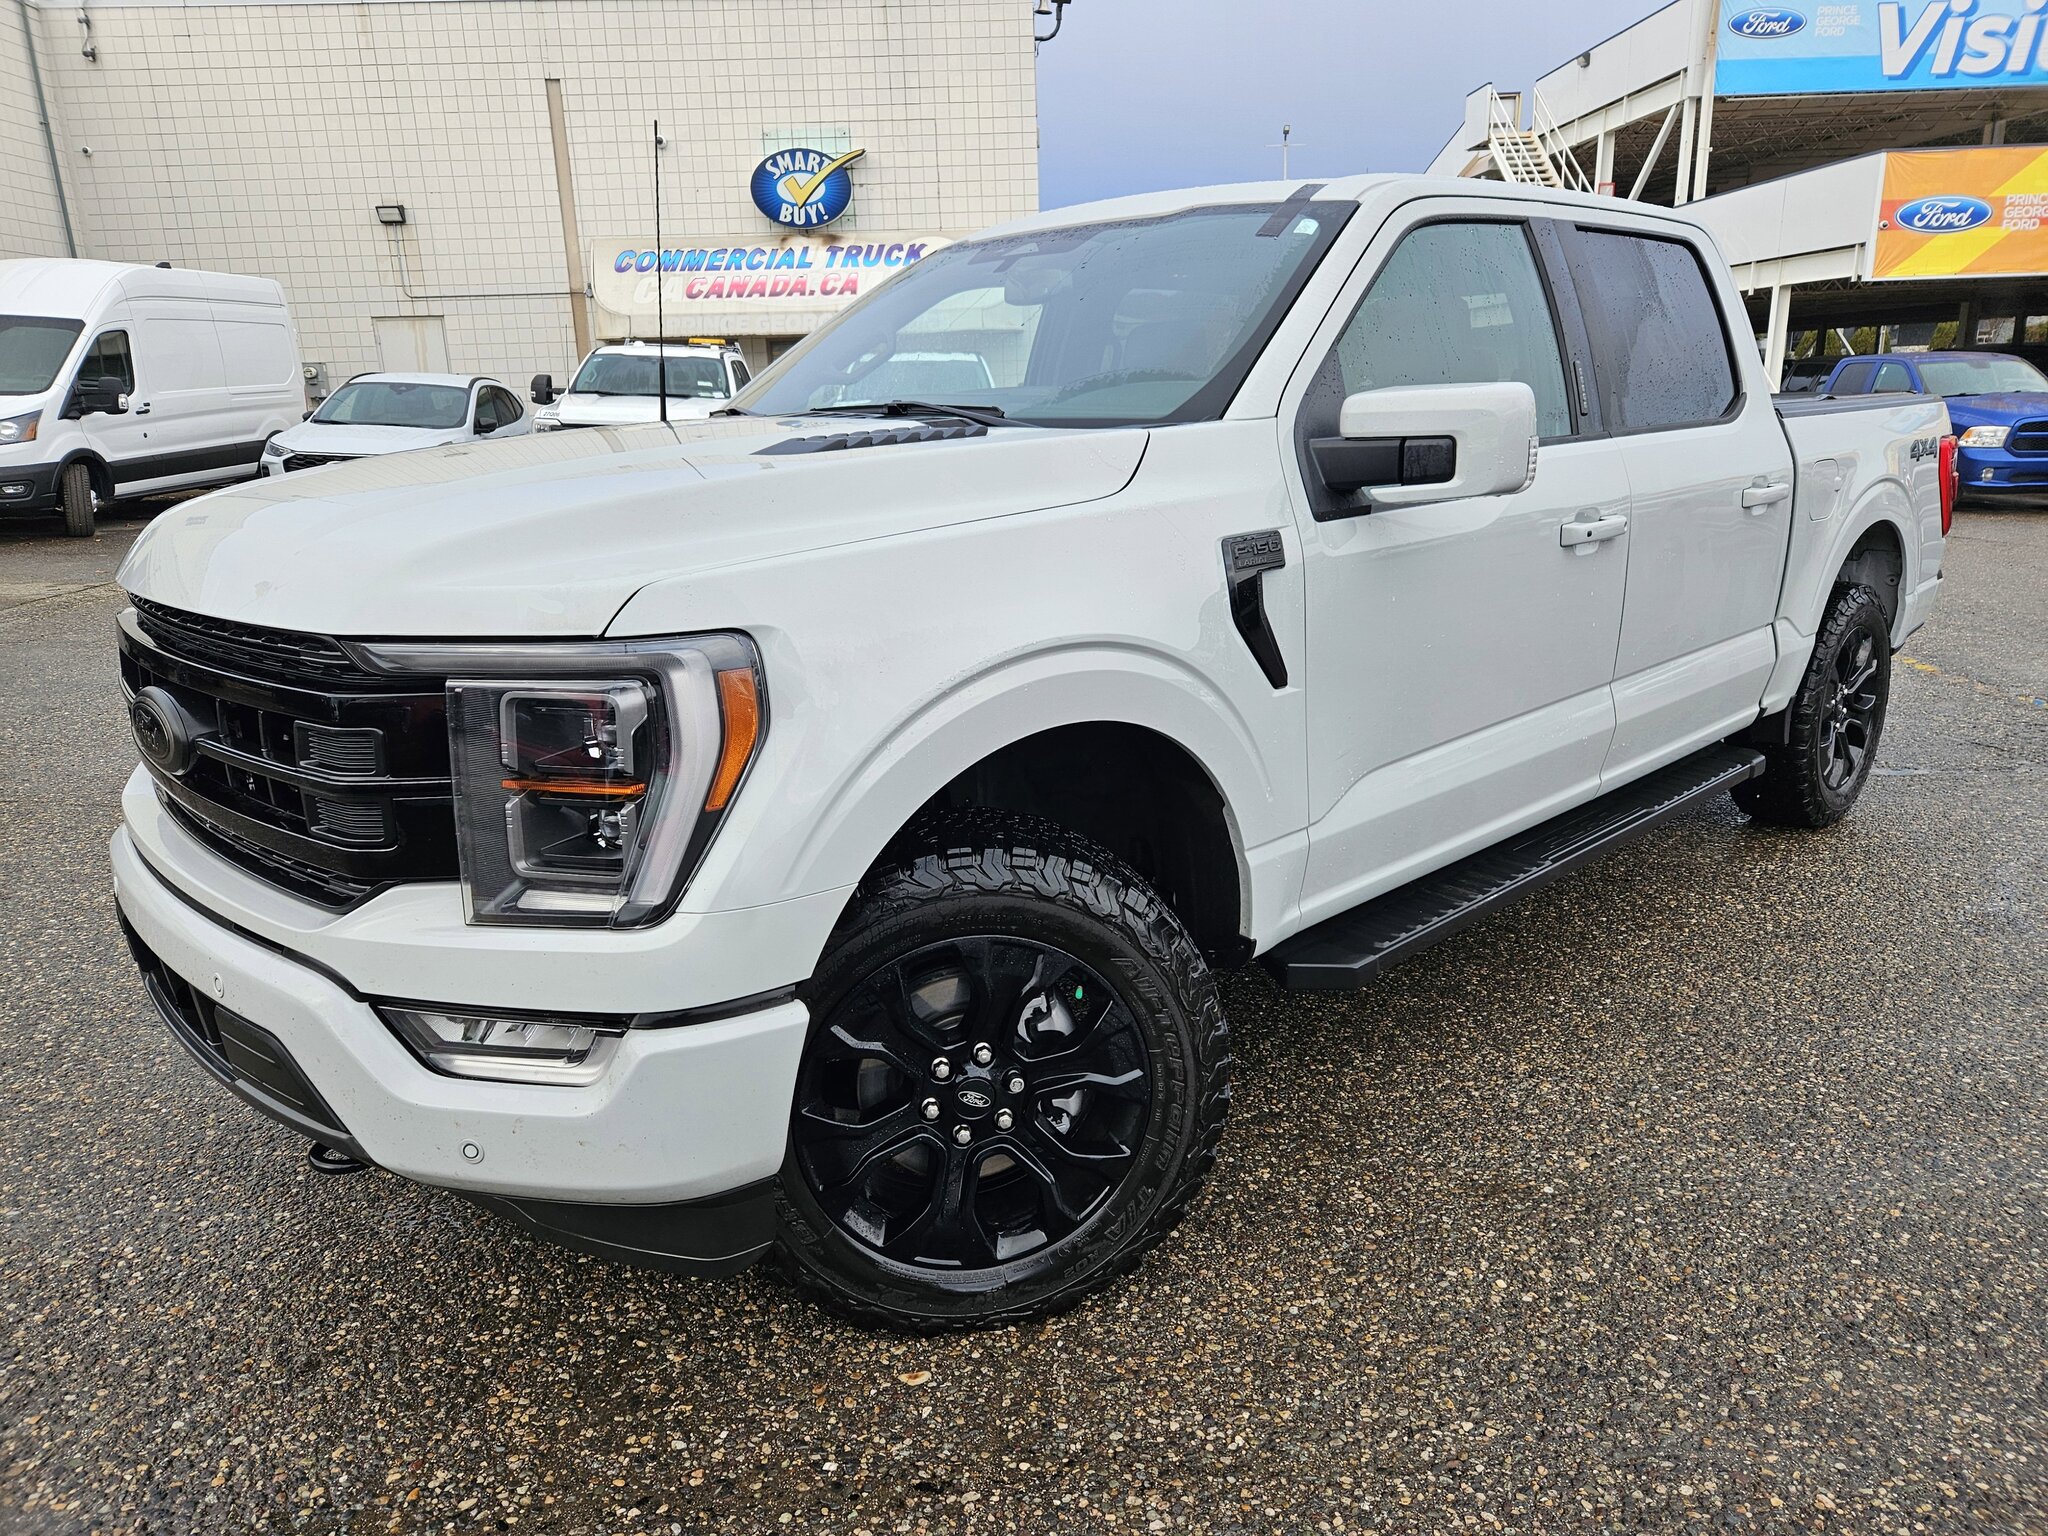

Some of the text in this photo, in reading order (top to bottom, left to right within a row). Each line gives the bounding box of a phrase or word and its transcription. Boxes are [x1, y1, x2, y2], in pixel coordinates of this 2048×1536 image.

[1816, 15, 1861, 26] GEORGE
[1817, 4, 1858, 15] PRINCE
[1742, 11, 1793, 34] Ford
[1814, 26, 1846, 37] FORD
[765, 151, 834, 180] SMART
[778, 202, 829, 225] BUY!
[1913, 199, 1975, 228] Ford
[2001, 218, 2041, 230] FORD
[613, 242, 928, 274] COMMERCIAL TRUCK
[685, 272, 859, 300] CANADA.CA
[1234, 539, 1281, 559] F-150
